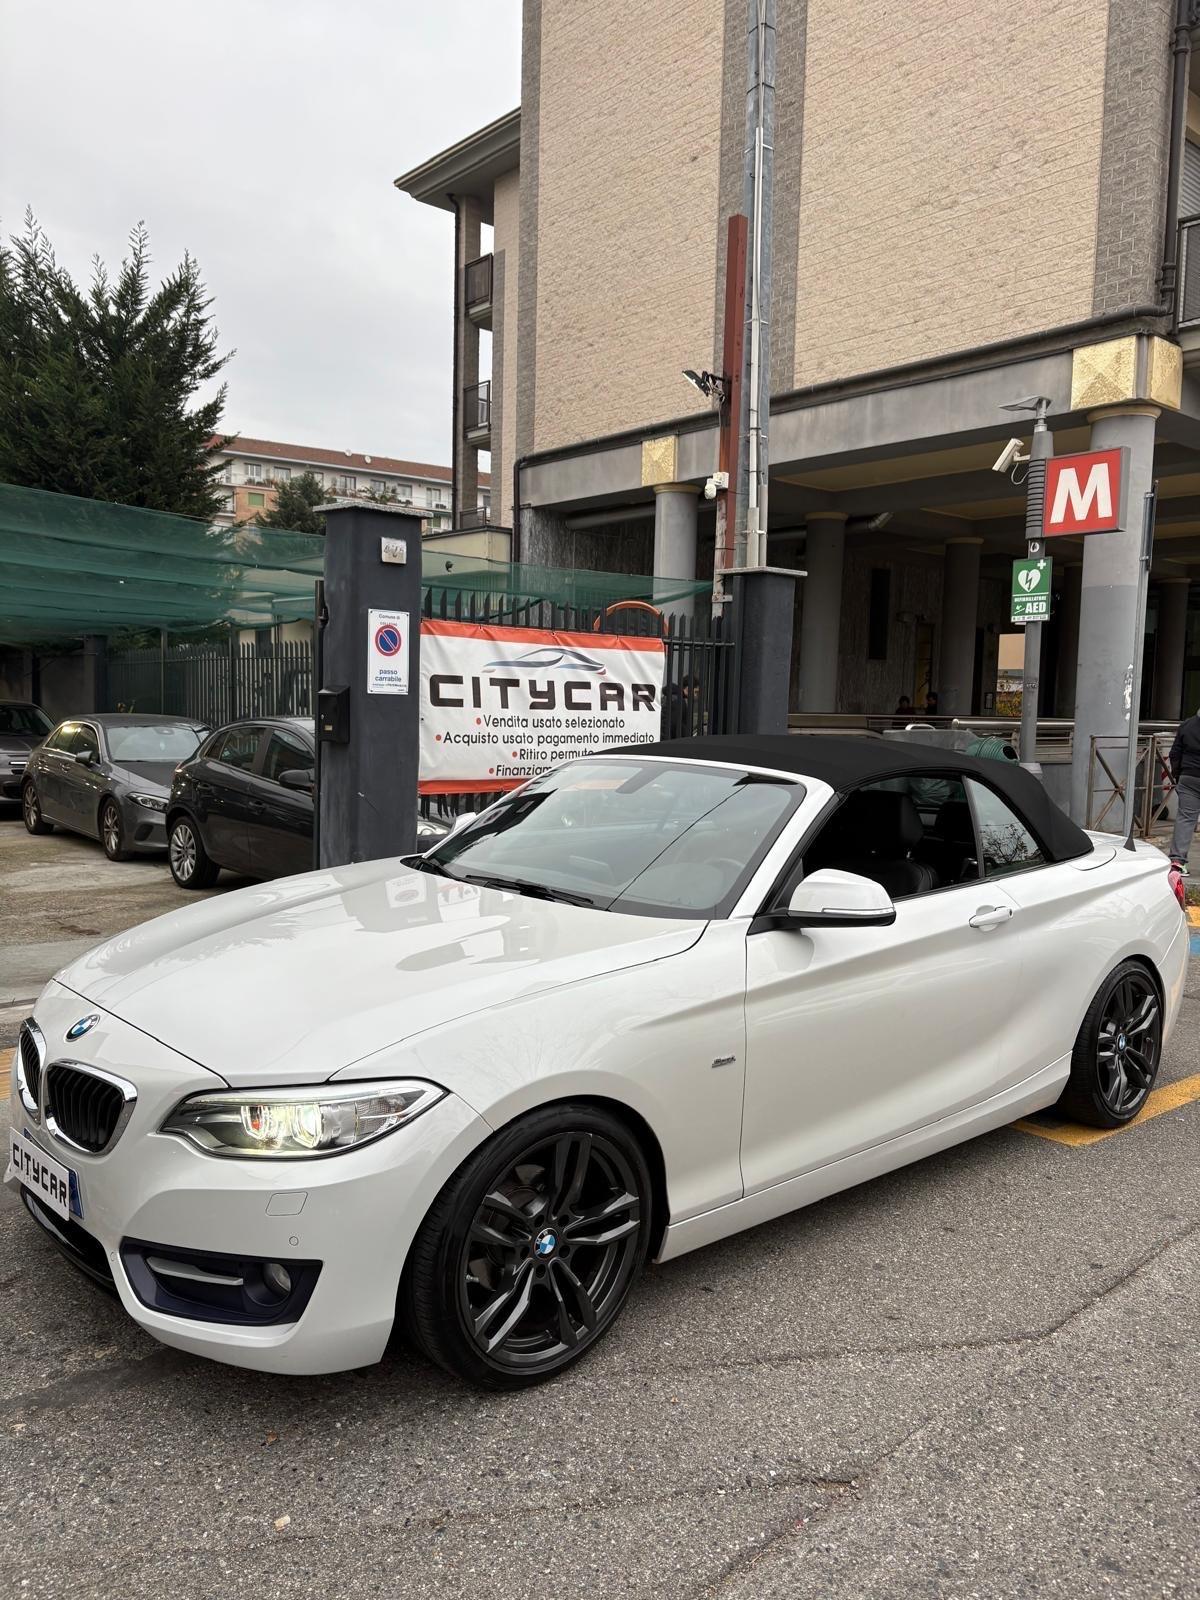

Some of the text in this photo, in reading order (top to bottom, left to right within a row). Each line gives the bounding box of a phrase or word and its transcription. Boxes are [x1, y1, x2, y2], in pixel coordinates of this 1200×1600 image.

[1050, 462, 1113, 524] M
[1025, 601, 1047, 614] AED
[430, 674, 656, 712] CITYCAR
[483, 714, 625, 729] Vendita usato selezionato
[443, 731, 655, 748] Acquisto usato pagamento immediato
[519, 748, 548, 761] Ritiro
[13, 1142, 67, 1207] CITYCAR
